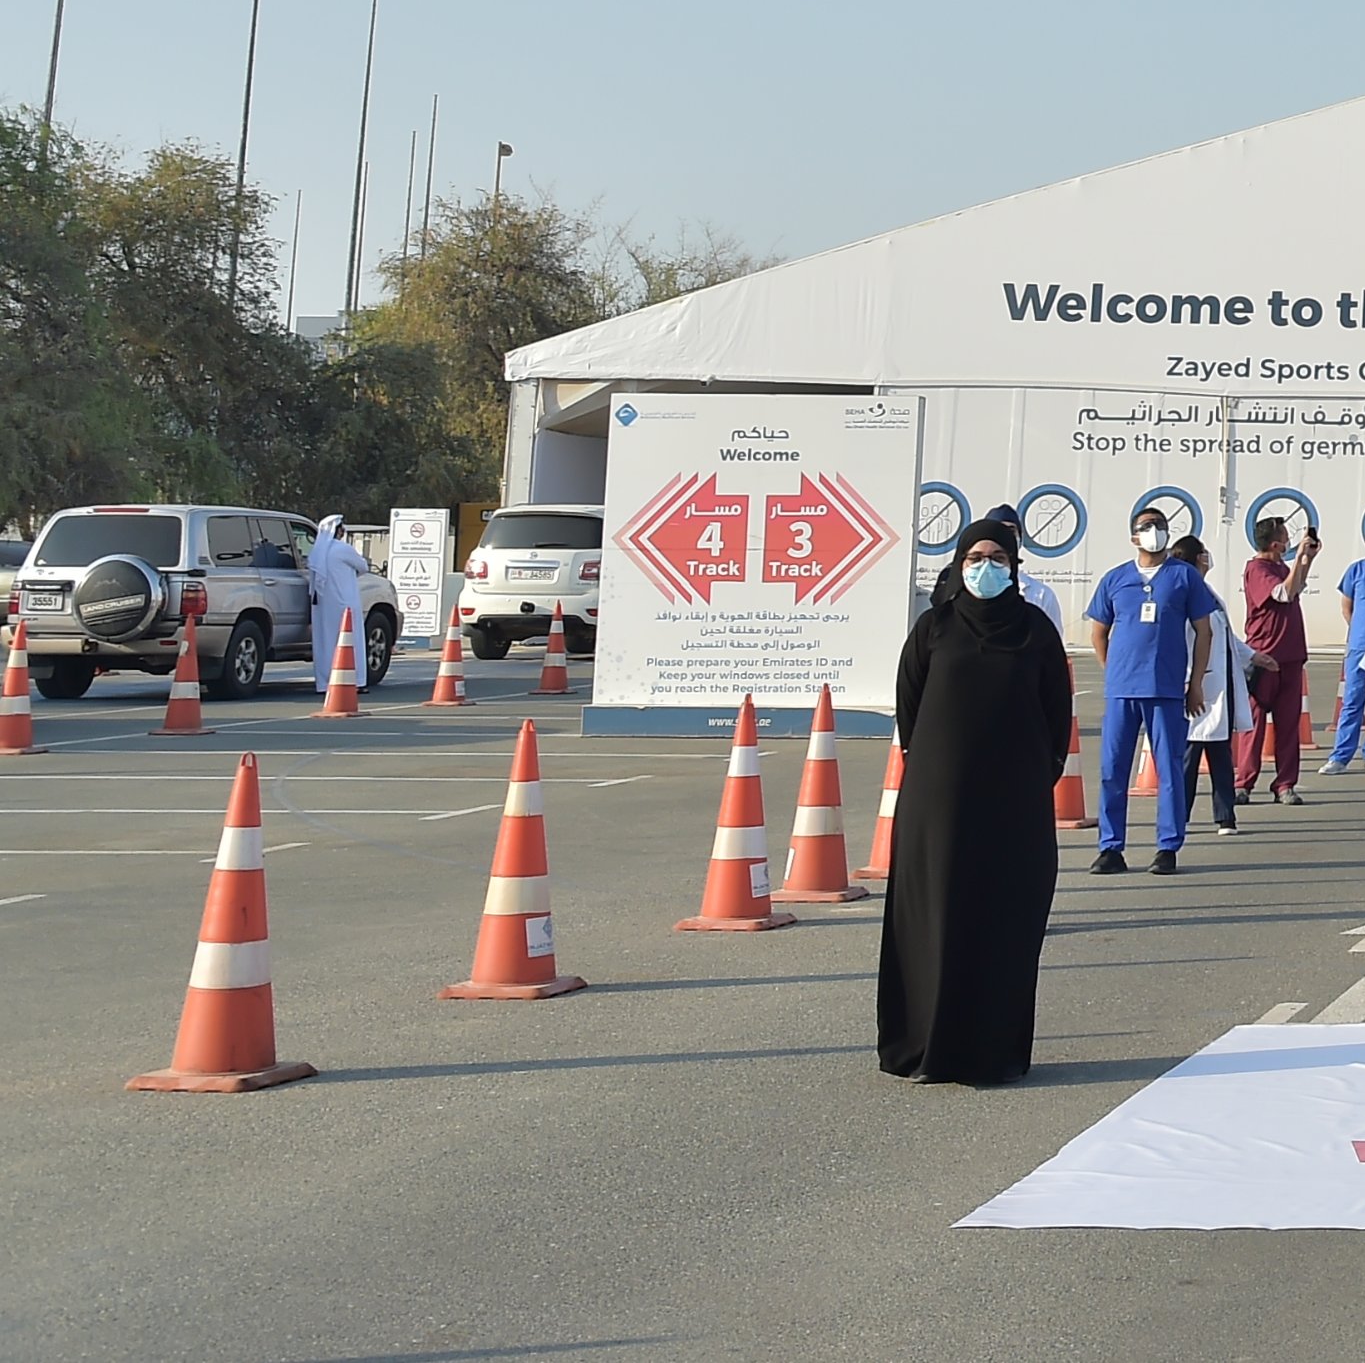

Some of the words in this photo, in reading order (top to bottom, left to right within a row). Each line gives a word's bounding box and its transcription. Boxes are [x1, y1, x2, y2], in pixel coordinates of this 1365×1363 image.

[1003, 282, 1254, 326] Welcome
[1267, 290, 1323, 327] to
[1166, 356, 1251, 383] Zayed
[1259, 358, 1350, 383] Sports
[1078, 400, 1199, 426] الجراثيم
[731, 426, 789, 442] حياكم
[1072, 431, 1126, 455] Stop
[1134, 432, 1172, 452] the
[1179, 433, 1261, 458] spread
[1269, 434, 1295, 453] of
[719, 448, 800, 462] Welcome
[684, 502, 741, 519] مسار
[770, 503, 827, 519] مسار
[696, 522, 725, 557] 4
[786, 522, 814, 558] 3
[687, 561, 740, 576] Track
[769, 562, 823, 577] Track
[83, 604, 104, 613] LAND
[104, 597, 143, 609] CRUISER
[646, 658, 683, 667] Please
[686, 659, 731, 668] prepare
[733, 659, 759, 668] your
[762, 658, 813, 667] Emirates
[815, 658, 828, 667] ID
[831, 658, 853, 667] and
[659, 671, 687, 680] Keep
[690, 672, 716, 681] your
[719, 671, 770, 680] windows
[773, 671, 810, 680] closed
[813, 671, 839, 680] until
[650, 685, 672, 695] you
[675, 683, 707, 693] reach
[710, 684, 729, 693] the
[732, 683, 801, 694] Registration
[804, 683, 846, 693] Staon
